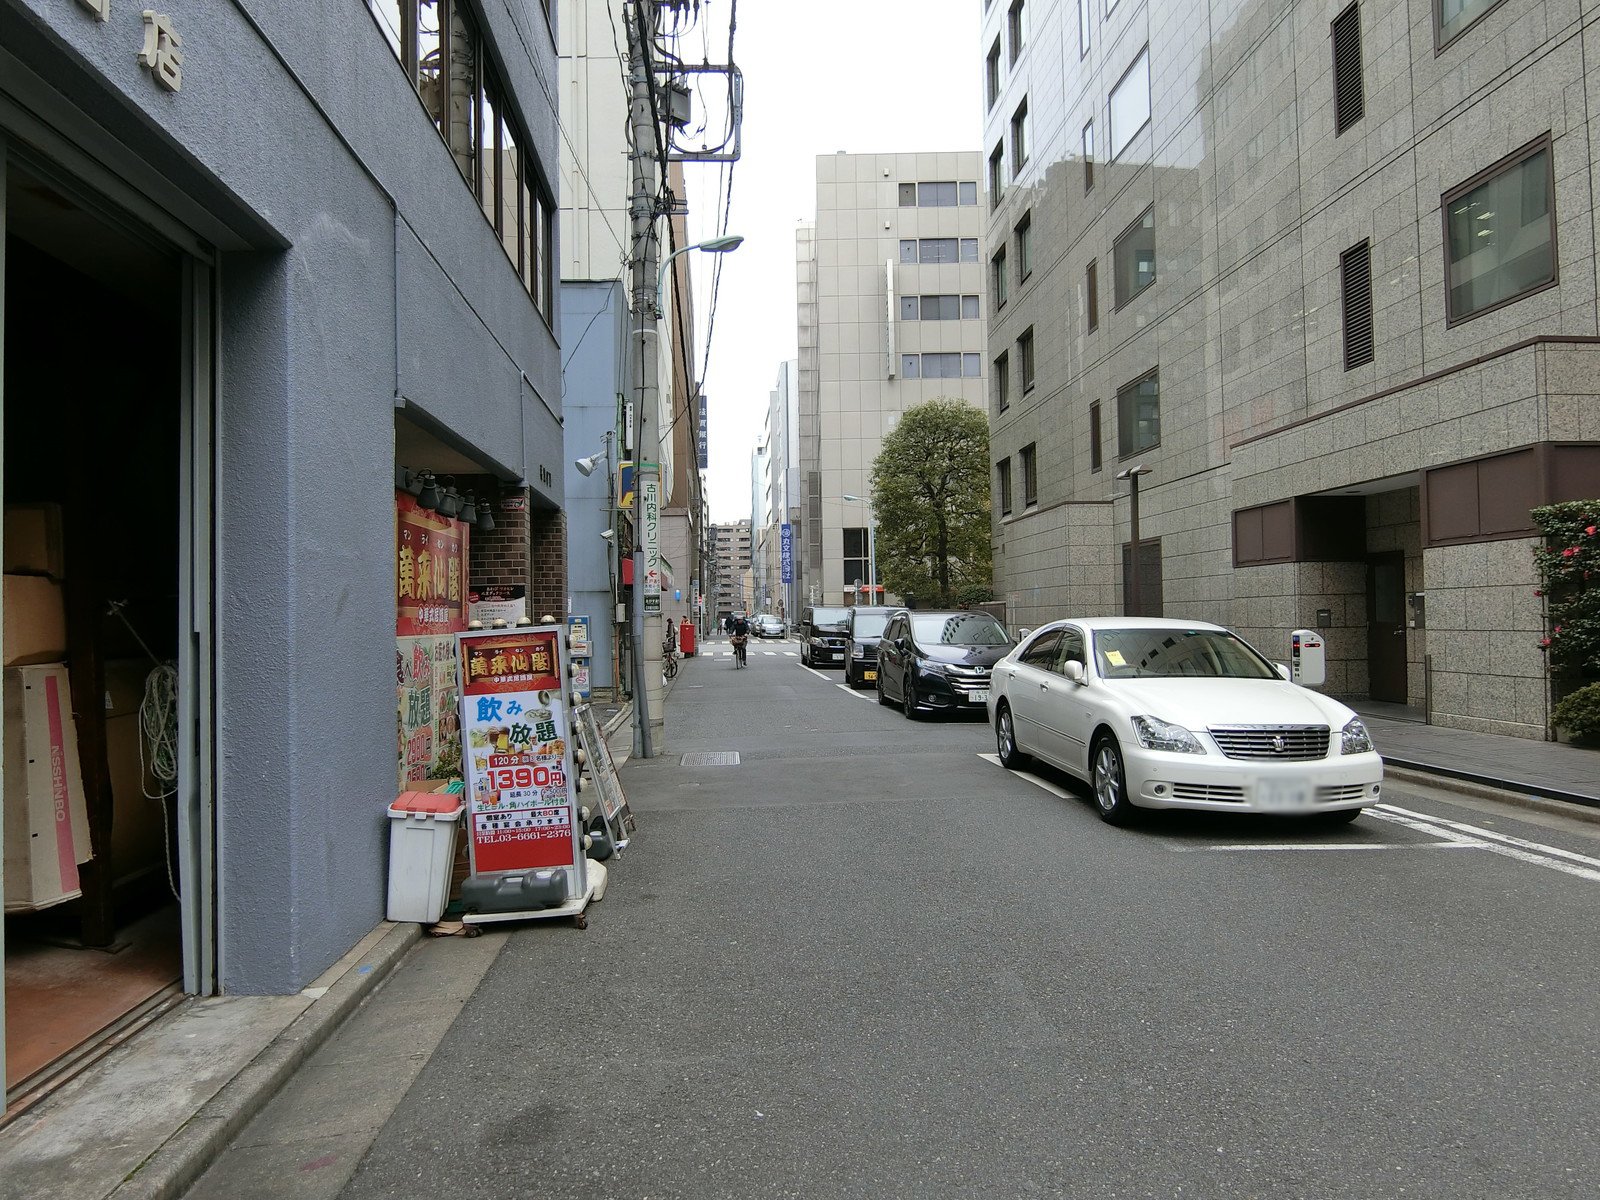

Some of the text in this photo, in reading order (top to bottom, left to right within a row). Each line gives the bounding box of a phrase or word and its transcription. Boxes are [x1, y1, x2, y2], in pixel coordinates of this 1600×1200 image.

[646, 483, 657, 568] 古川内科クリニック
[408, 687, 431, 730] 放題
[476, 697, 523, 722] 飲み
[509, 720, 558, 745] 放題
[493, 755, 520, 765] 120分
[487, 767, 563, 790] 1390円
[485, 813, 513, 821] 個室あり
[476, 830, 571, 845] TEL.03-6661-2376
